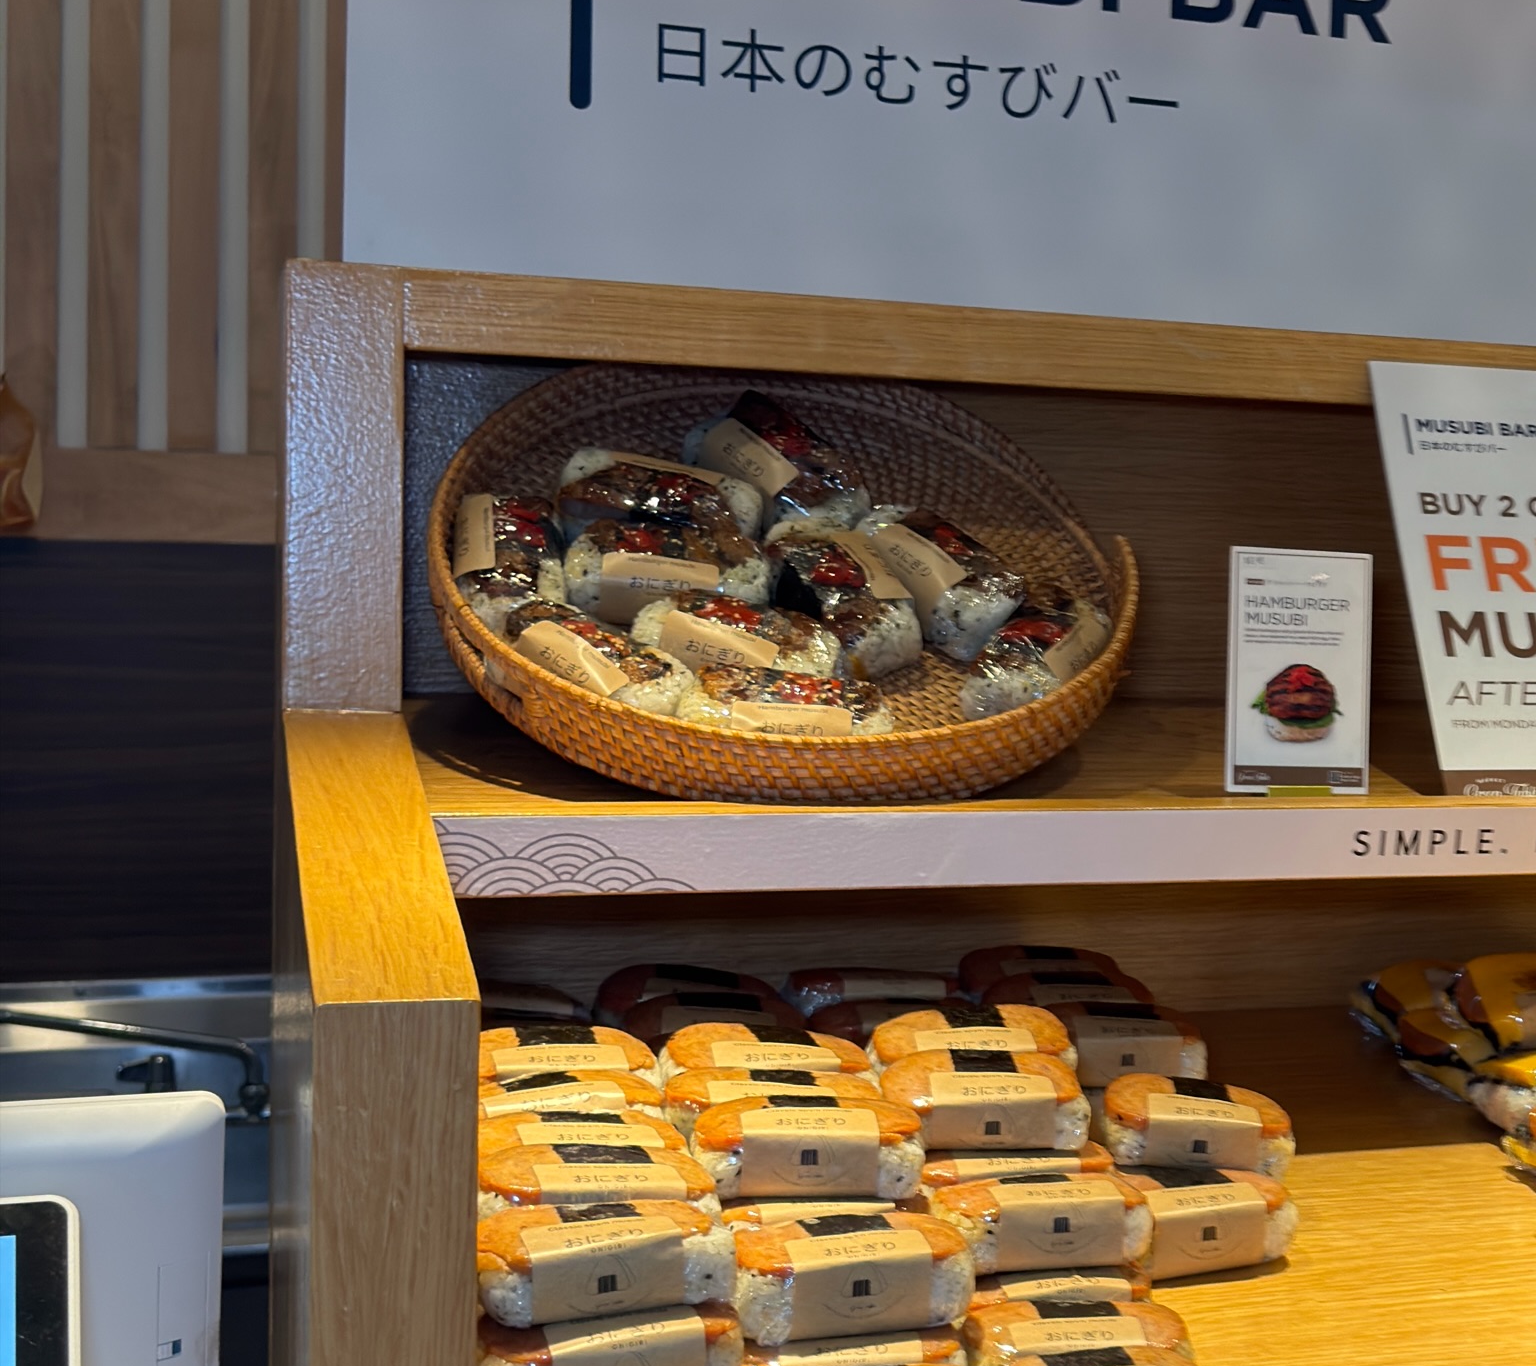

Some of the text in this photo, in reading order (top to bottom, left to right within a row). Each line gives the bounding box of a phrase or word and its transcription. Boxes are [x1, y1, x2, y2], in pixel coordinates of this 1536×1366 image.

[656, 22, 1180, 123] 日本のむすびバー
[1415, 418, 1493, 436] MUSUBI
[1418, 492, 1486, 516] BUY
[1500, 496, 1518, 518] 2
[1245, 595, 1350, 612] HAMBURGER
[1245, 612, 1308, 627] MUSUBI
[1353, 829, 1509, 857] SIMPLE.
[565, 1227, 643, 1249] おにぎり
[824, 1240, 896, 1257] おにぎり
